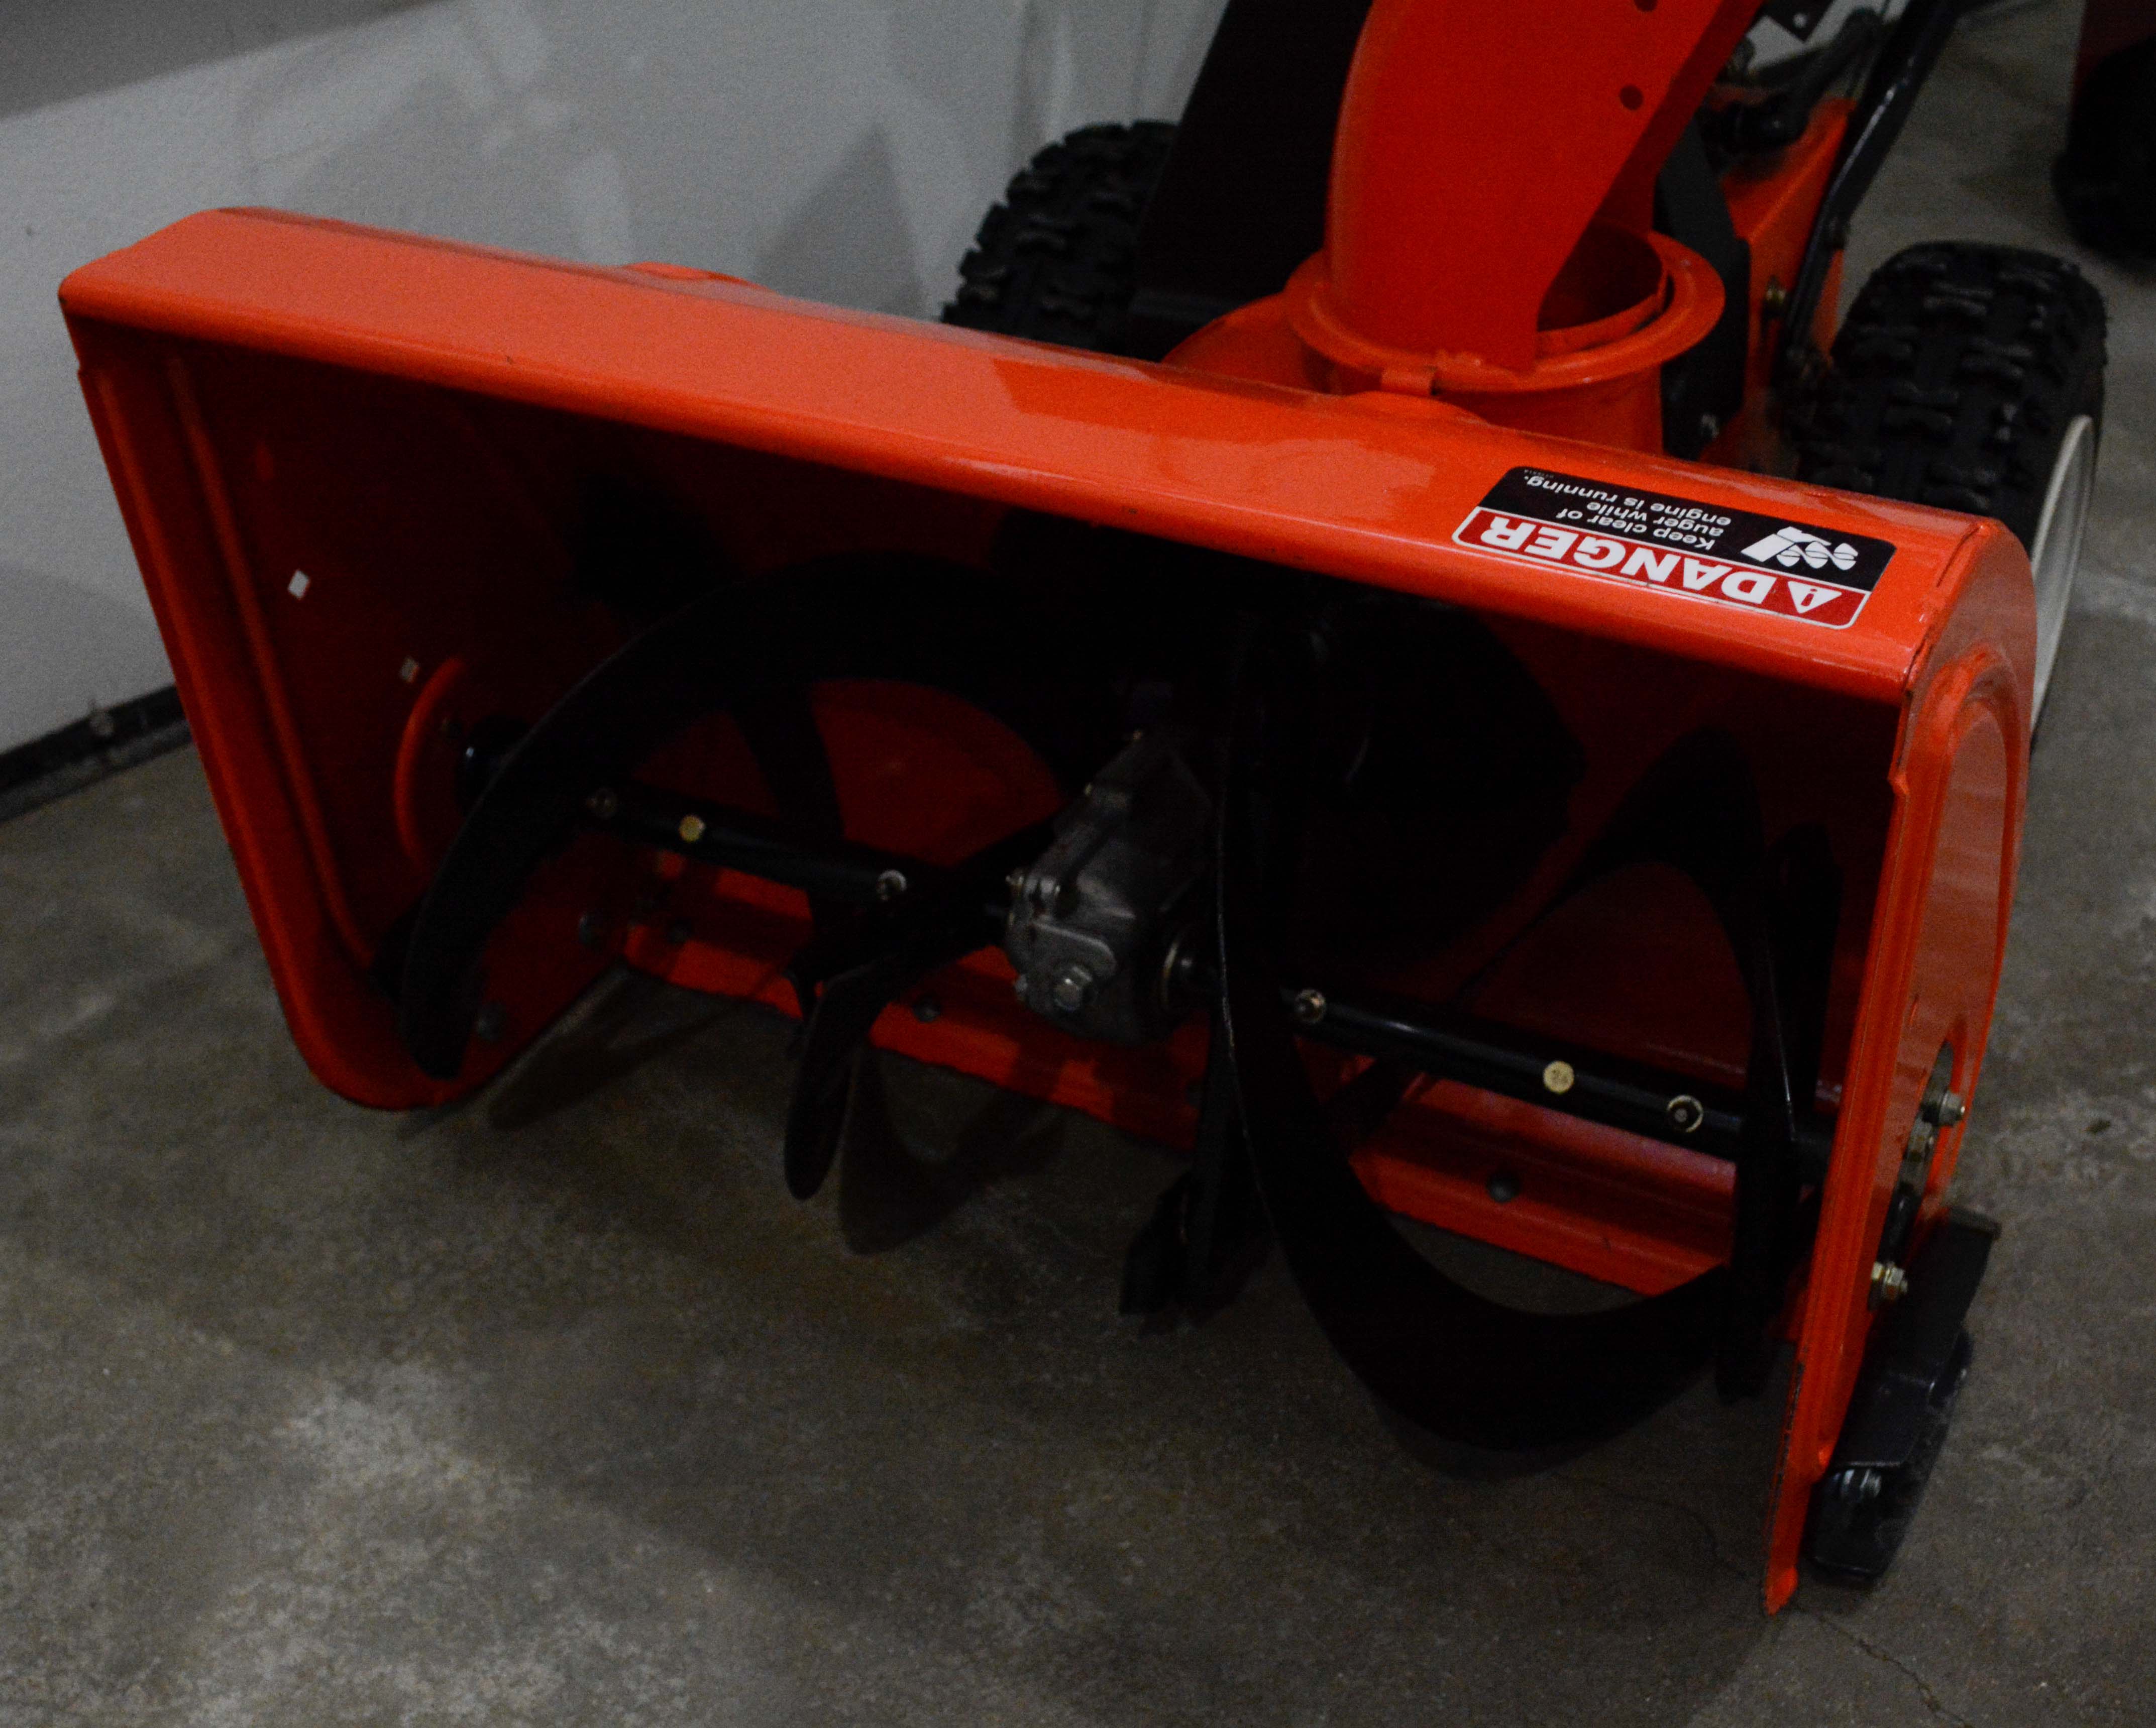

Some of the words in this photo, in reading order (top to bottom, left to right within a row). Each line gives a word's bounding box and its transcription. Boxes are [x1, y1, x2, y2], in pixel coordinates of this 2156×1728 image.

[1524, 473, 1618, 502] running.
[1556, 508, 1583, 519] of
[1586, 502, 1647, 521] while
[1624, 497, 1645, 510] is
[1650, 503, 1731, 525] engine
[1587, 515, 1647, 534] clear
[1653, 516, 1724, 536] auger
[1653, 527, 1715, 551] Keep
[1480, 516, 1777, 604] DANGER
